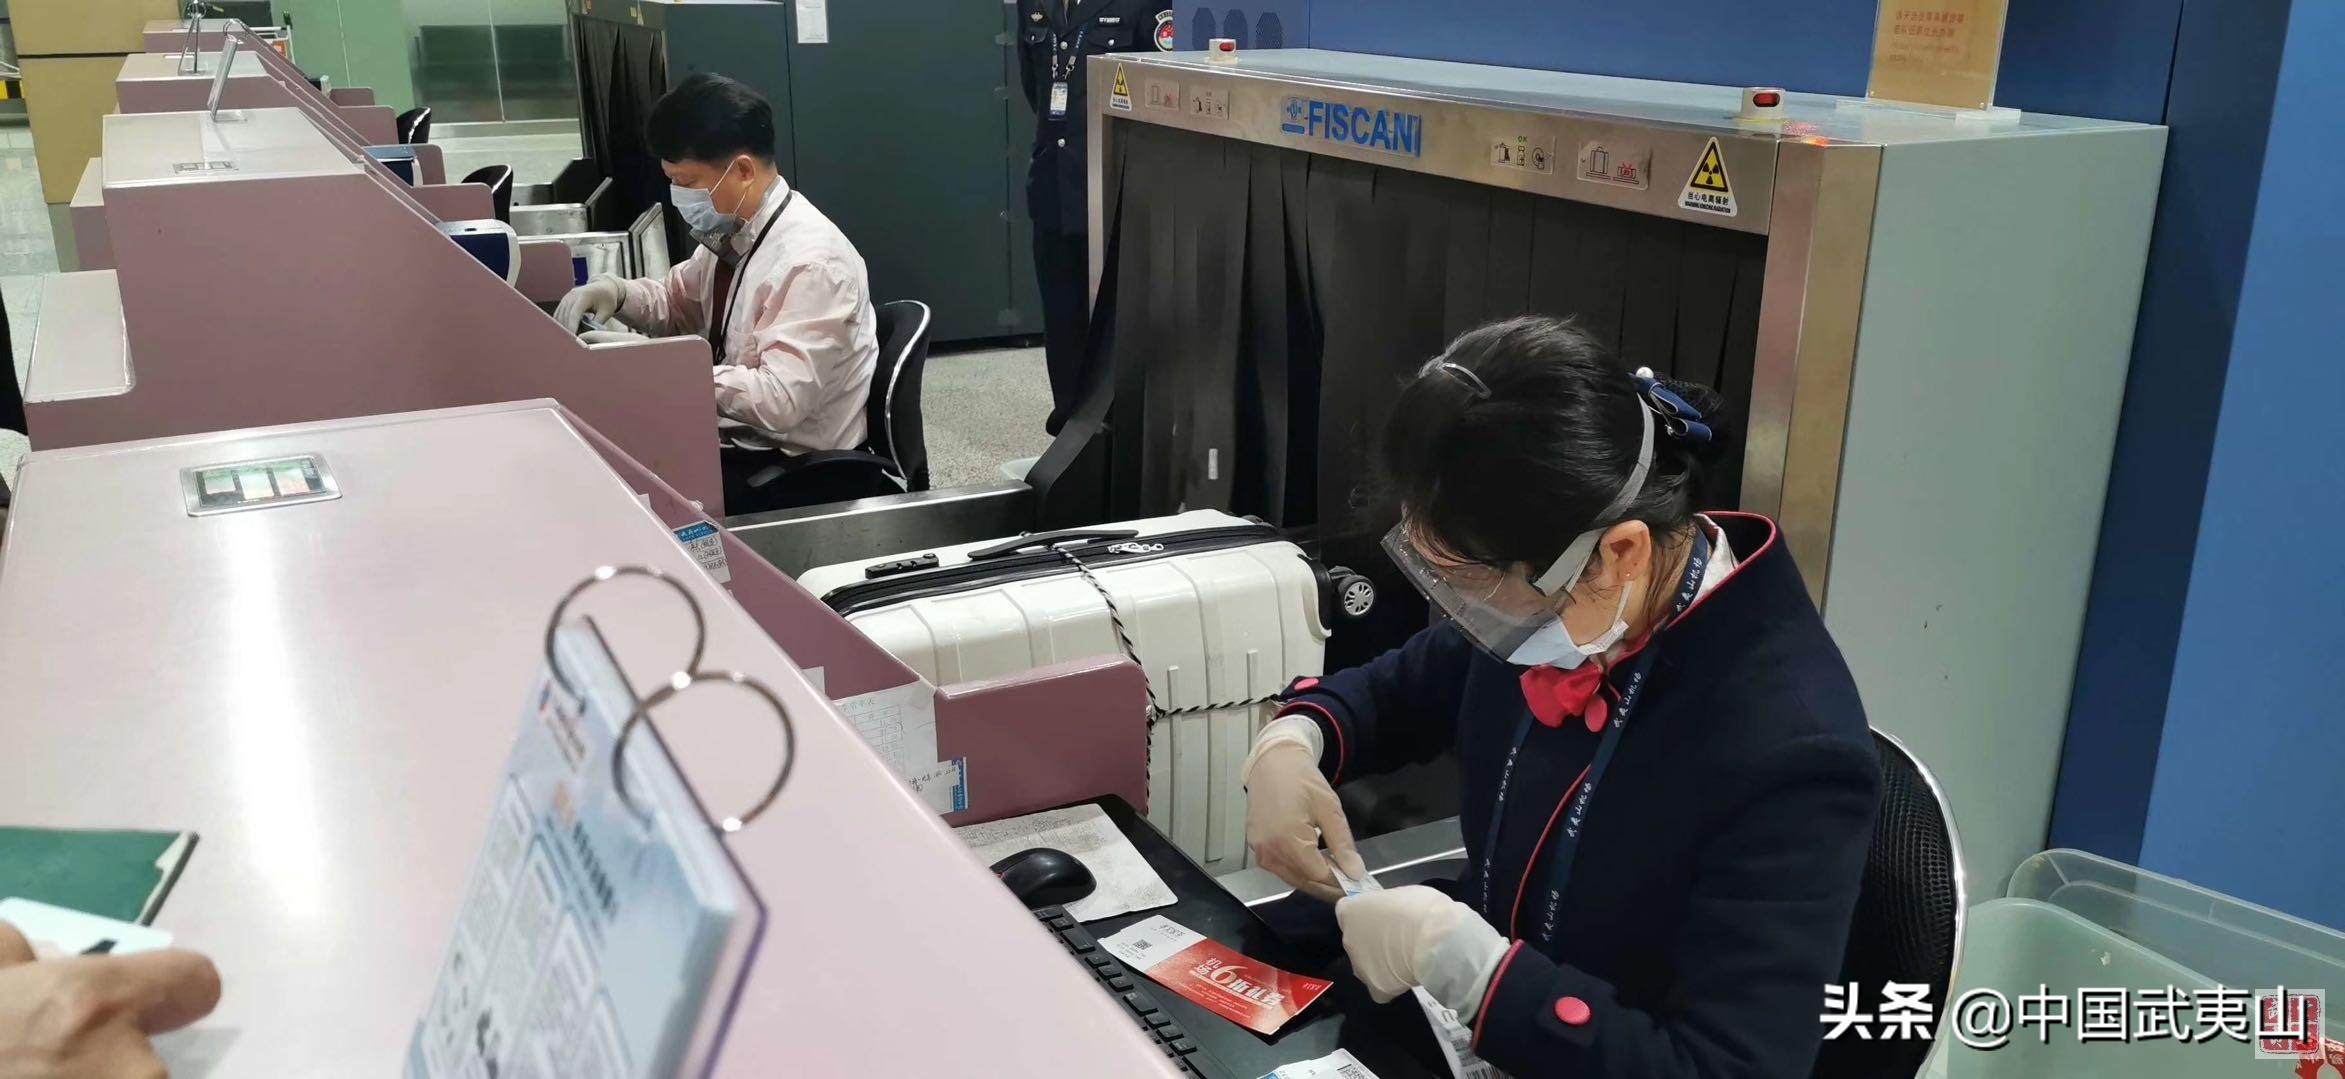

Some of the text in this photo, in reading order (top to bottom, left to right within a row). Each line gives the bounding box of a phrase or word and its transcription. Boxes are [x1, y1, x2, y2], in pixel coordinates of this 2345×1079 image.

[1308, 100, 1413, 153] FISCAN
[1687, 192, 1729, 205] 当心电离辐射
